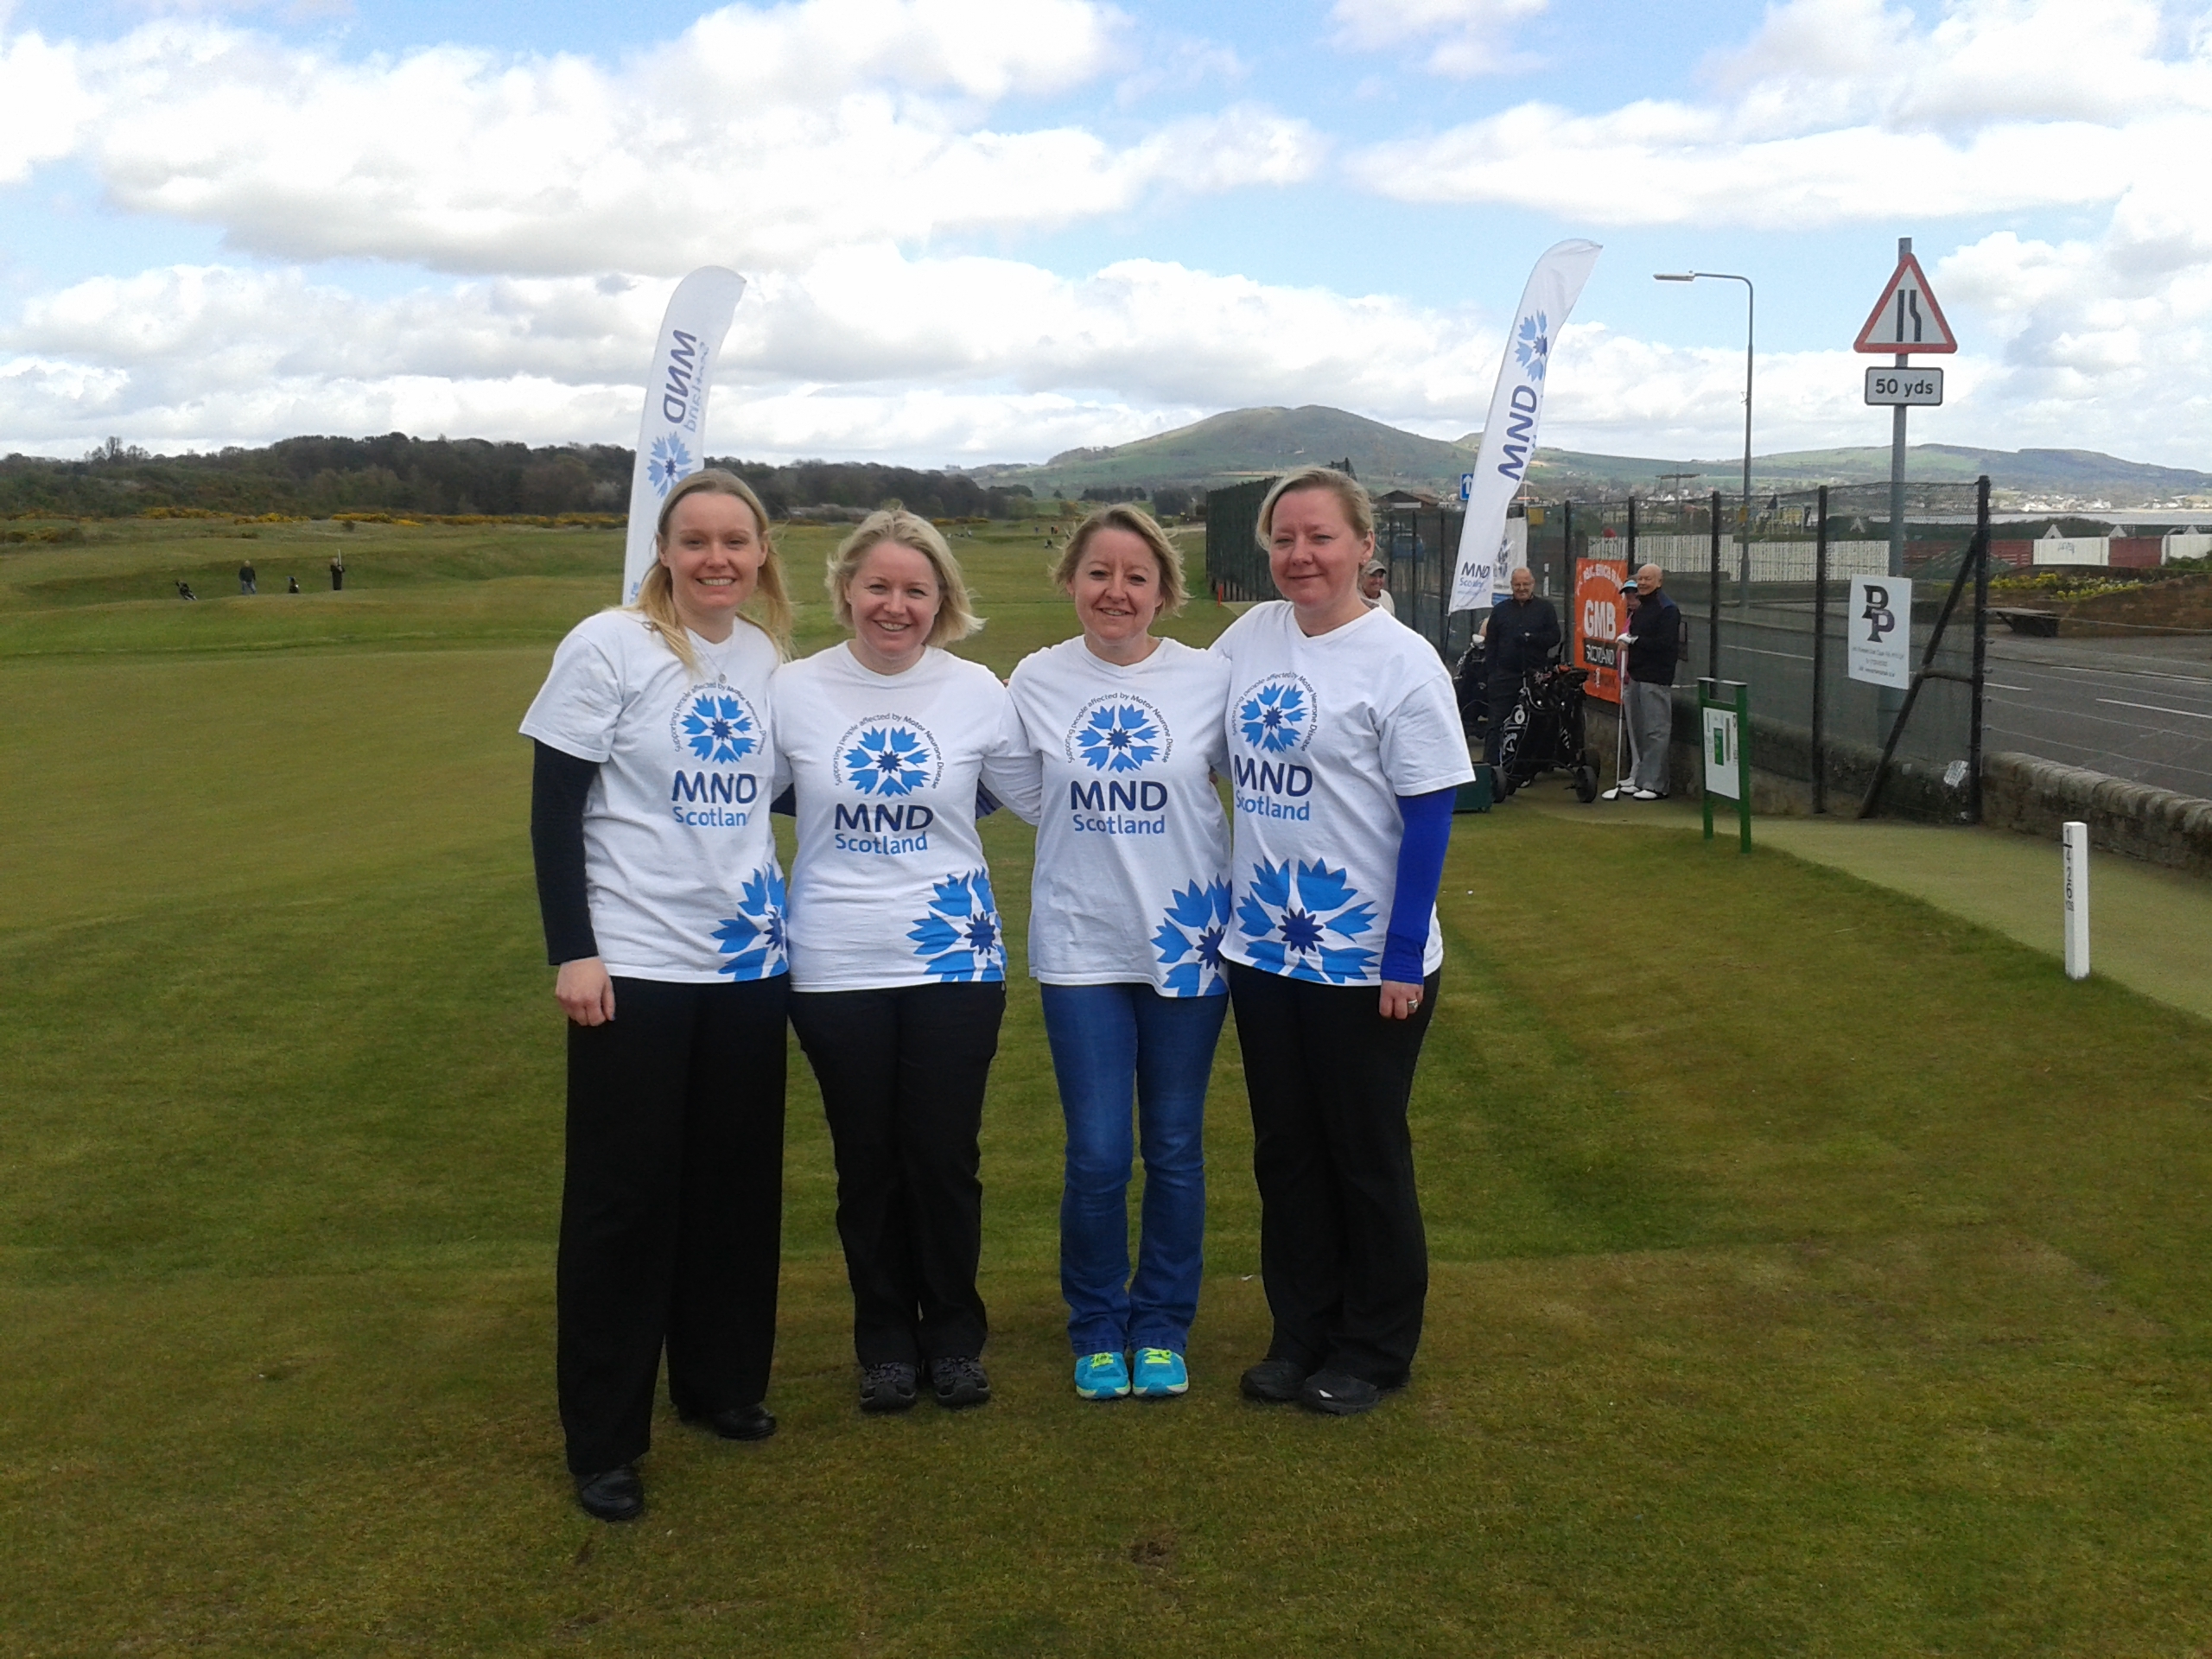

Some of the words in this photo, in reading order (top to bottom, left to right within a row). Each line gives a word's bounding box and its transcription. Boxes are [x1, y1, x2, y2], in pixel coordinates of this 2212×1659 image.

[1875, 378, 1898, 394] 50
[1904, 379, 1933, 397] yds
[1497, 385, 1537, 481] MND
[1584, 599, 1616, 640] GMB
[717, 683, 726, 691] by
[1266, 671, 1291, 683] affected
[1298, 675, 1314, 694] Motor
[1088, 692, 1118, 708] affected
[1120, 691, 1129, 701] by
[1130, 694, 1154, 710] Motor
[859, 713, 891, 726] affected
[892, 713, 901, 722] by
[903, 715, 925, 732] Motor
[1071, 705, 1089, 729] people
[1153, 709, 1171, 737] Neurone
[839, 724, 859, 746] people
[925, 730, 942, 760] Neurone
[1065, 728, 1076, 764] Supporting
[1300, 724, 1318, 752] Disease
[1161, 738, 1173, 764] Disease
[671, 770, 758, 804] MND
[931, 761, 944, 789] Disease
[1234, 754, 1313, 798] MND
[1071, 780, 1168, 812] MND
[1236, 790, 1310, 821] Scotland
[673, 806, 747, 827] Scotlan
[835, 803, 934, 833] MND
[1072, 814, 1165, 835] Scotland
[835, 830, 928, 855] Scotland
